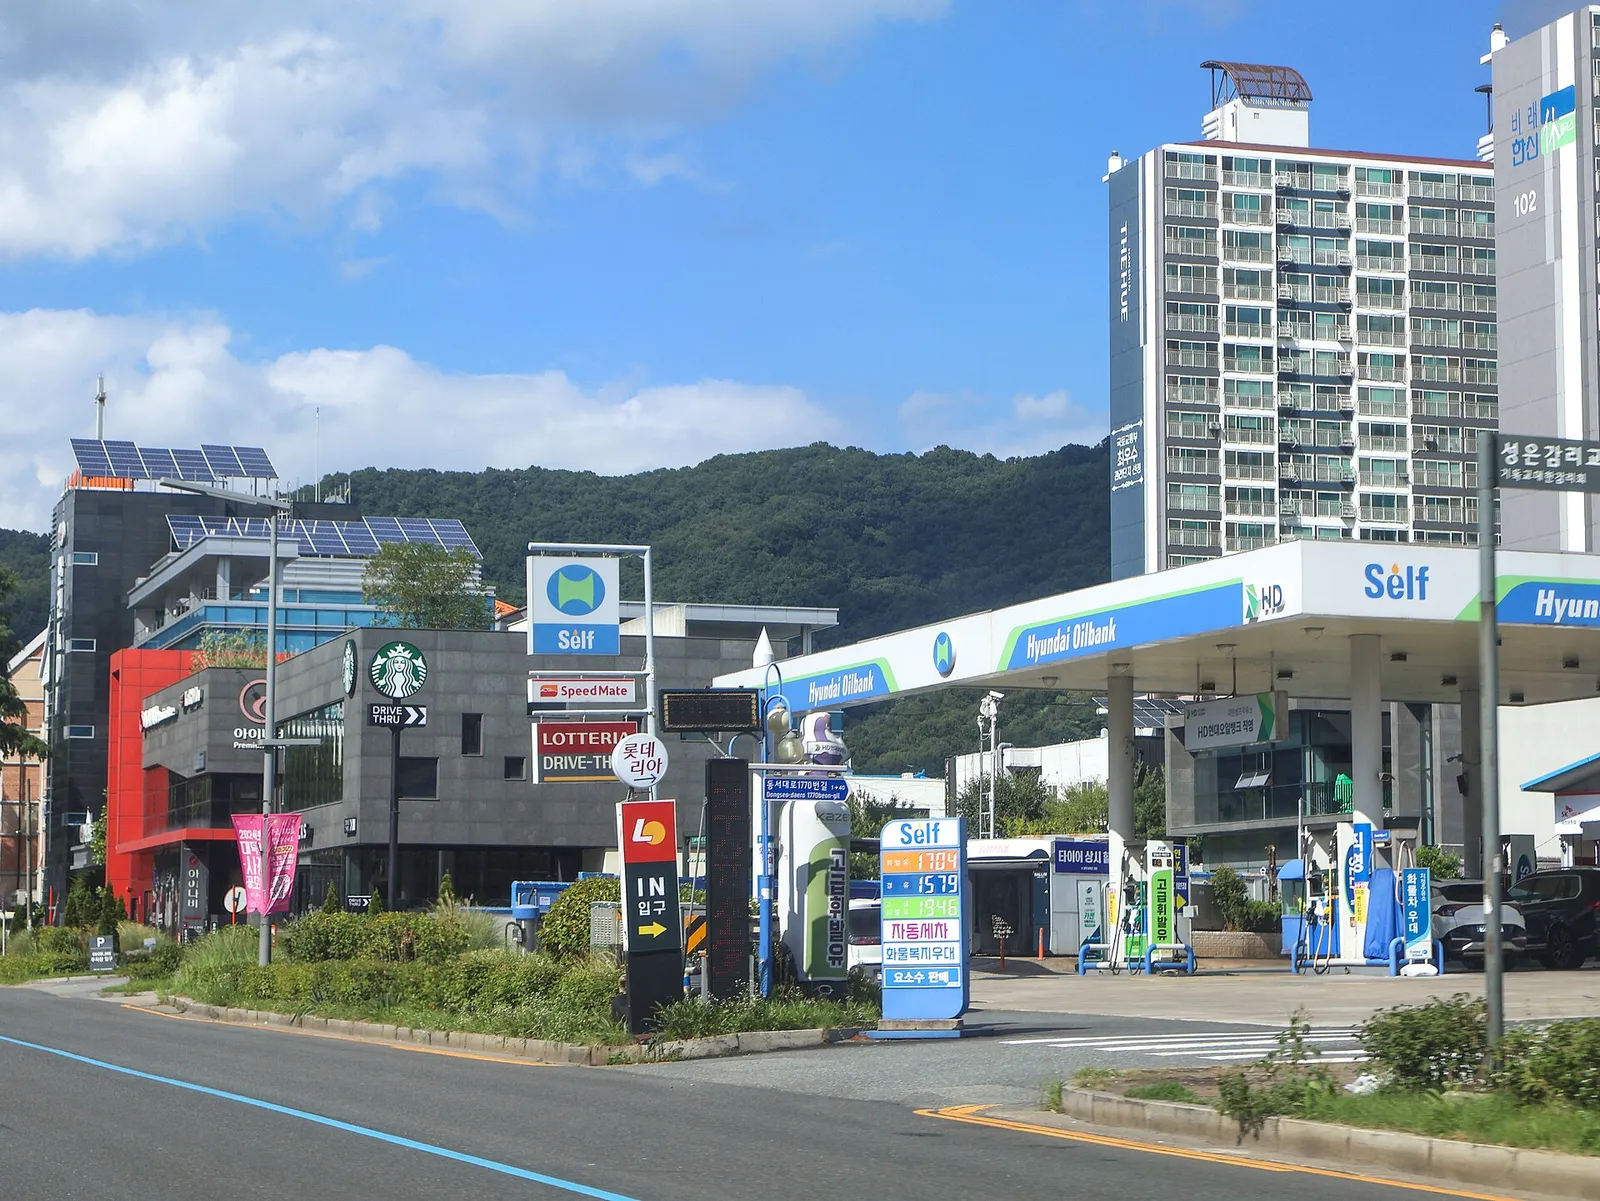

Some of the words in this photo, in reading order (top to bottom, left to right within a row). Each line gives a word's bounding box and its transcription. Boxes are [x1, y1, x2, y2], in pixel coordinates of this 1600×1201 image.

[1511, 132, 1539, 167] 한신
[1514, 189, 1537, 217] 102
[1117, 444, 1139, 467] 최우수
[1364, 562, 1430, 601] Self
[1261, 584, 1283, 611] HD
[1534, 588, 1600, 624] Hyun
[558, 629, 595, 650] Self
[1027, 624, 1071, 663] Hyundai
[1072, 616, 1117, 650] Oilbank
[808, 675, 841, 707] Hyundai
[842, 669, 874, 697] Oilbank
[372, 706, 403, 715] DRIVE
[372, 714, 400, 724] THRU
[1197, 720, 1242, 739] HD현대오일뱅크
[1242, 718, 1254, 733] 직영
[623, 741, 656, 760] 롯데
[543, 755, 612, 770] DRIVE-TH
[630, 757, 663, 776] 리아
[766, 780, 828, 791] 동서대로1770번길
[766, 791, 806, 800] Dongseo-daero
[900, 822, 940, 845] Self
[918, 852, 958, 871] 1704
[1058, 849, 1083, 863] 타이어
[1084, 850, 1102, 864] 상시
[187, 869, 200, 909] 아이나비
[637, 876, 665, 898] IN
[918, 875, 958, 894] 1579
[1407, 873, 1419, 908] 화물차
[638, 900, 667, 916] 입구
[829, 849, 846, 968] 고급휘발유
[919, 899, 957, 916] 1946
[1156, 878, 1168, 942] 고급휘발유
[891, 922, 948, 940] 자동세차
[1408, 910, 1419, 934] 우대
[96, 937, 106, 948] P
[886, 946, 955, 961] 화물복지우대
[893, 971, 926, 984] 요소수
[927, 970, 949, 984] 판매
